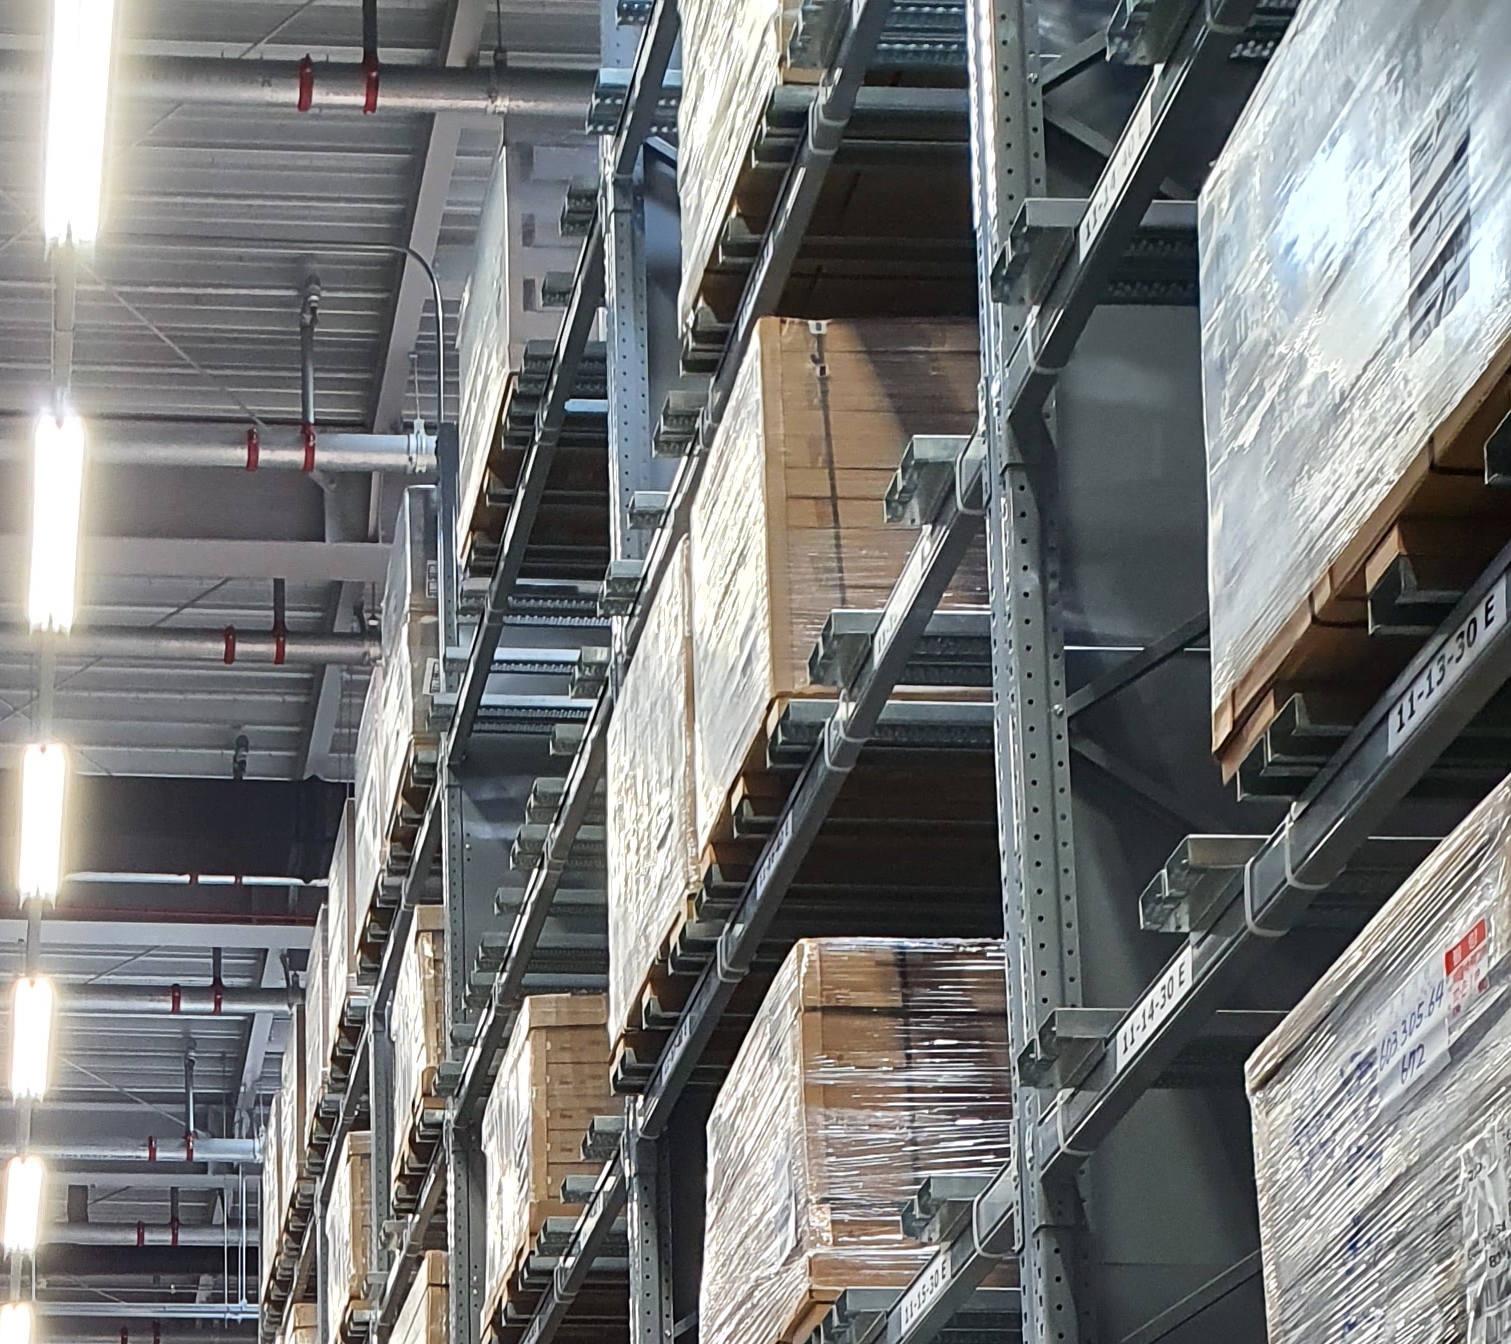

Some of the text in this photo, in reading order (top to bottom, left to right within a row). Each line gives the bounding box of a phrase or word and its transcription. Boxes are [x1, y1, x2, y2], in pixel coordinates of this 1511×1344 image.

[1397, 594, 1495, 734] 11-13-30 E
[1122, 961, 1186, 1056] 11-14-30 E
[905, 1257, 947, 1325] 11-15-30 E
